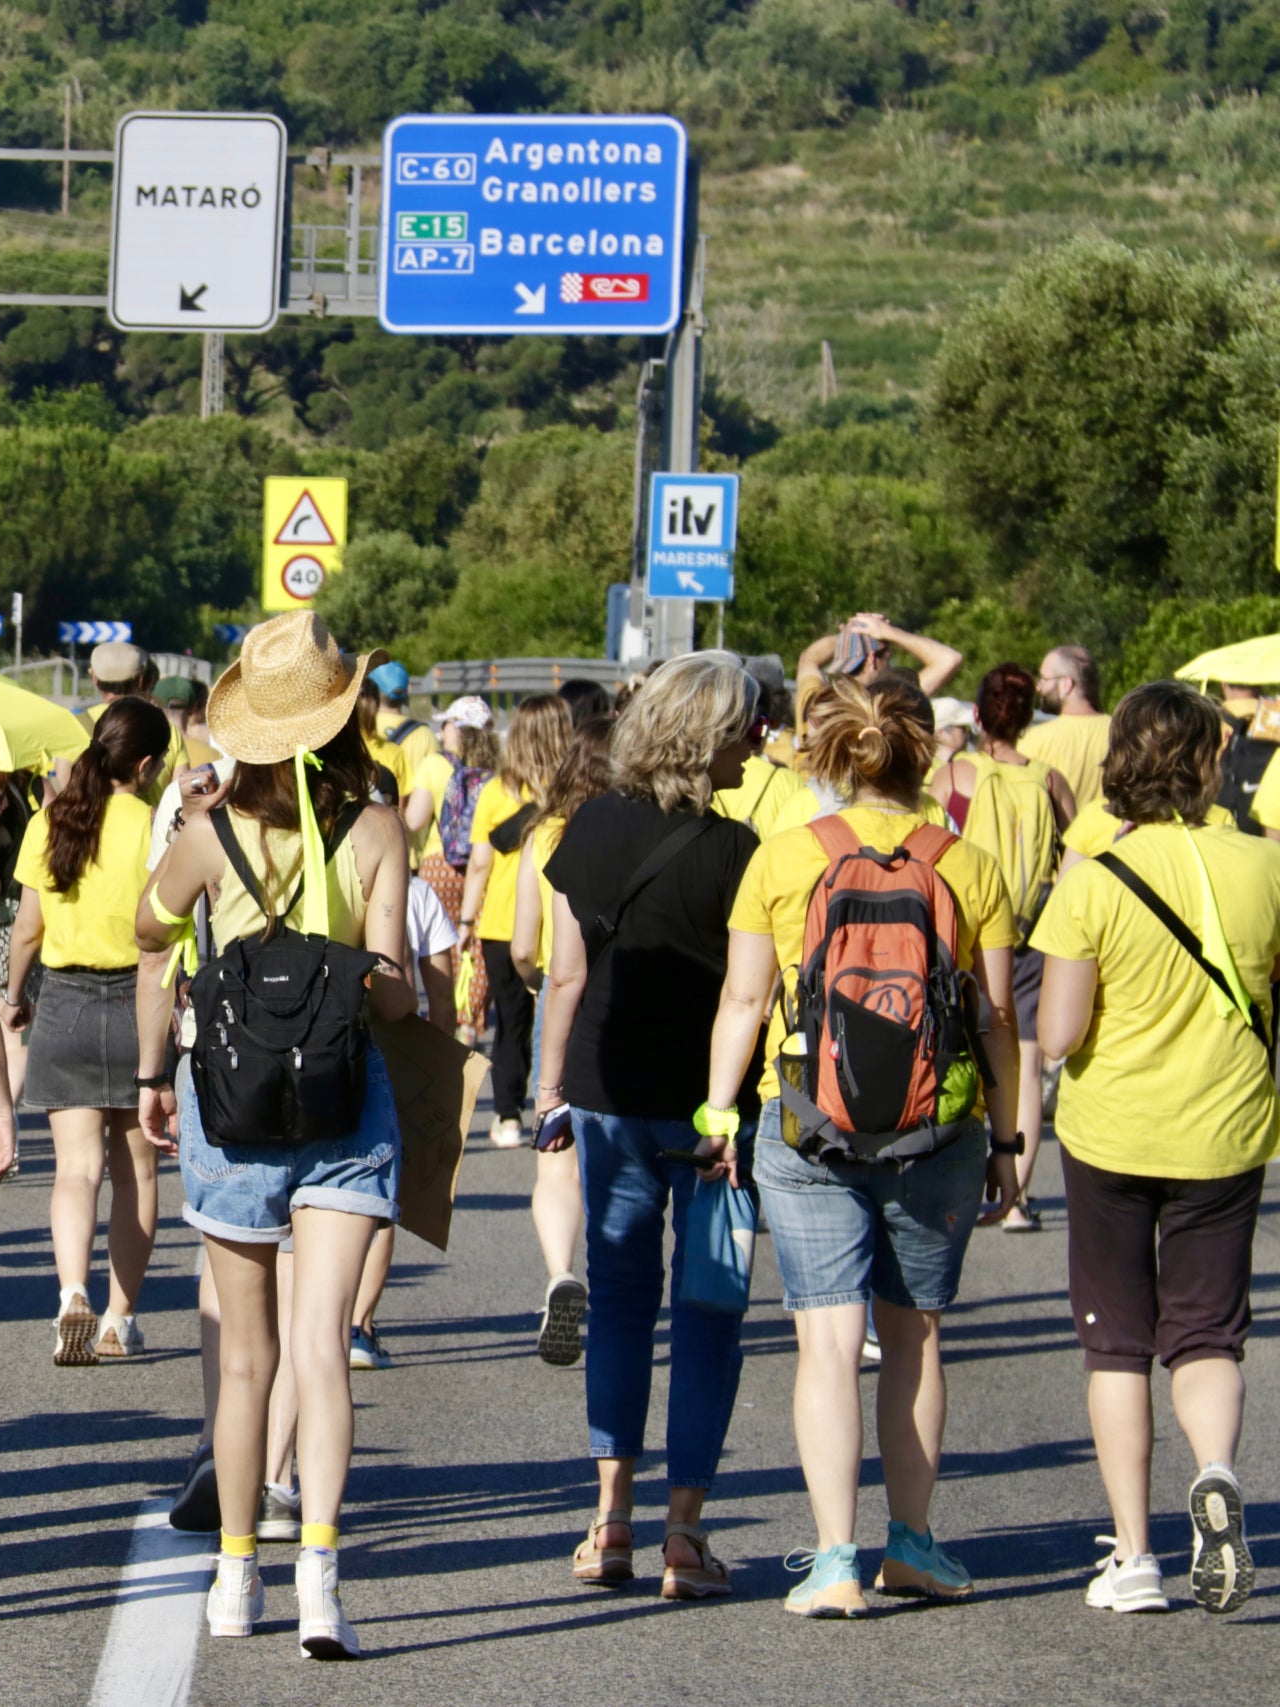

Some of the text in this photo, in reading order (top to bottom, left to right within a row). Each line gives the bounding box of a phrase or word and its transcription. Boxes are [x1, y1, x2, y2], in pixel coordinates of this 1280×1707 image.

[484, 137, 662, 171] Argentona
[401, 158, 472, 180] C-60
[136, 182, 262, 208] MATARÓ
[482, 176, 657, 203] Granollers
[400, 216, 464, 238] E-15
[480, 228, 664, 256] Barcelona
[399, 248, 470, 270] AP-7
[654, 551, 729, 567] MARESME
[290, 570, 319, 584] 40
